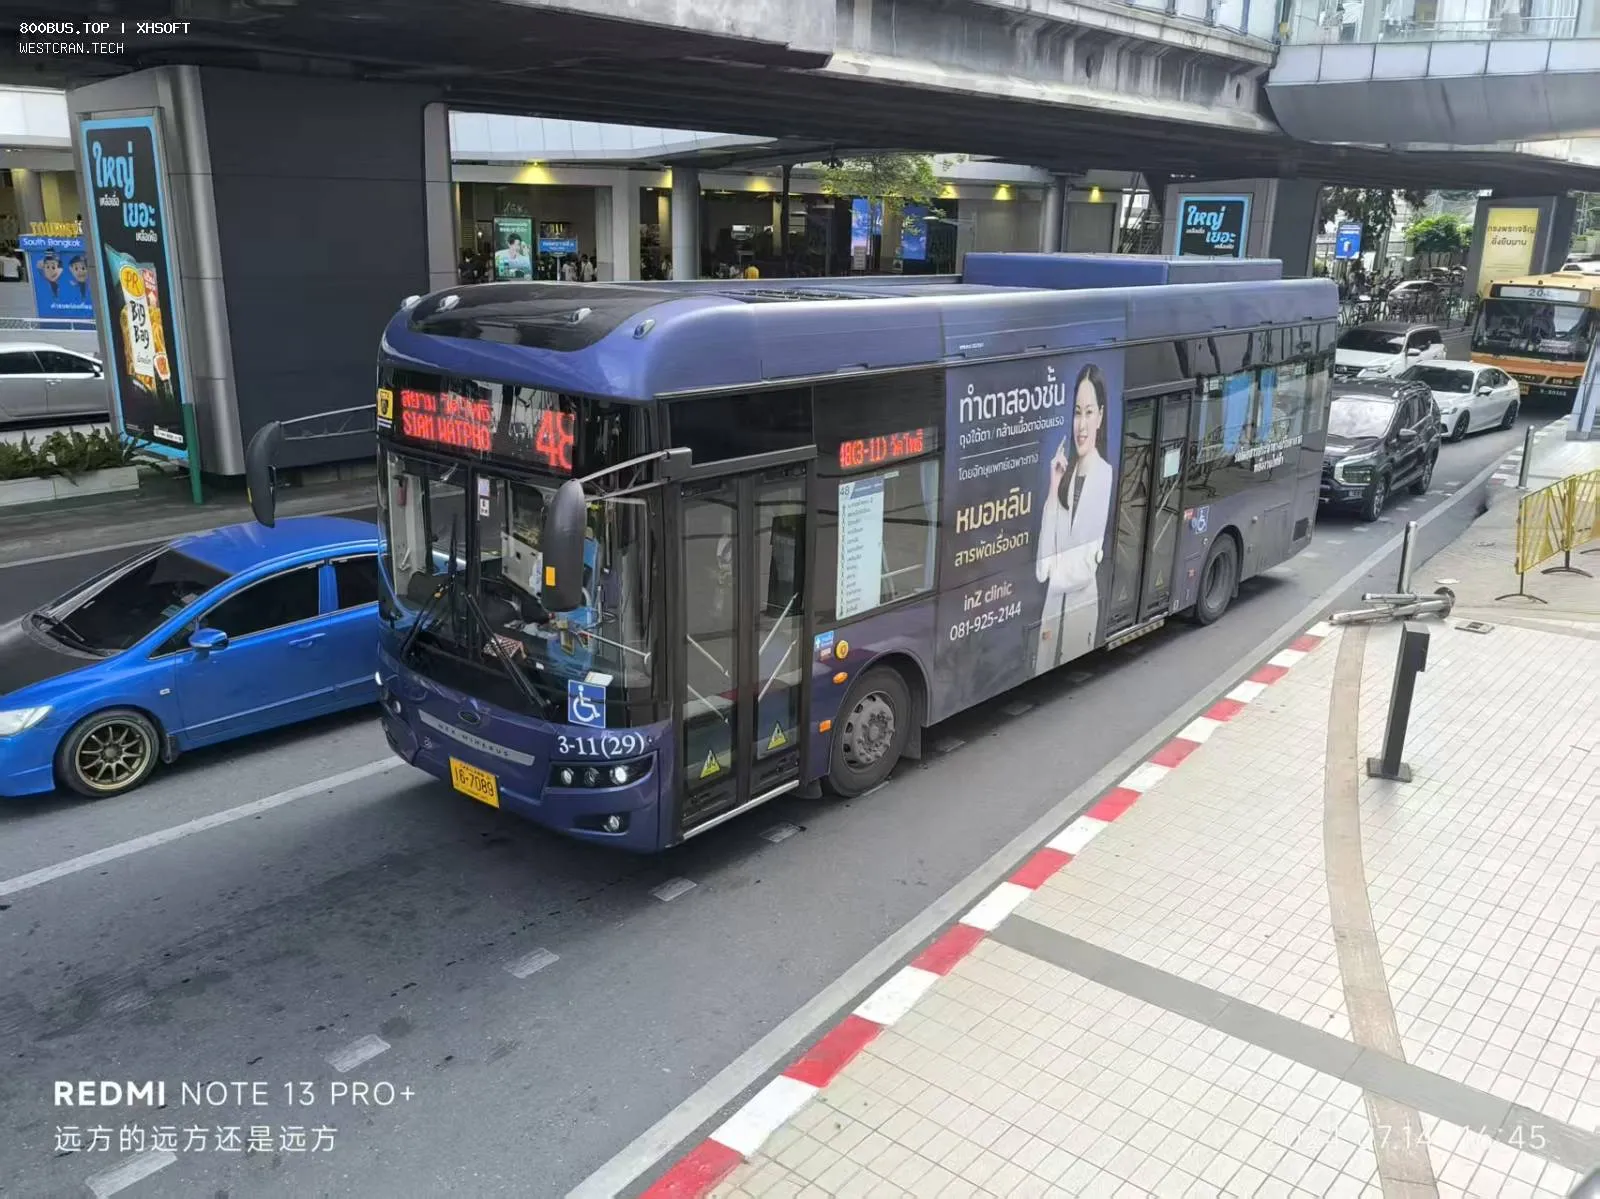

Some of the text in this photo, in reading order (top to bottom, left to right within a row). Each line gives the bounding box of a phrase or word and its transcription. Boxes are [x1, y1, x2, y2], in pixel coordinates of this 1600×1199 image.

[92, 141, 135, 199] ใหญ่
[123, 202, 156, 228] เยอะ
[1187, 205, 1226, 231] ใหญ่
[23, 238, 81, 249] South Bangkok
[1206, 231, 1237, 244] เยอะ
[130, 300, 147, 327] Big
[133, 325, 150, 349] Bag
[959, 366, 1066, 424] ทำตาสองชั้น
[402, 410, 436, 440] SIAM
[959, 427, 991, 452] ถุงใต้ตา
[956, 486, 1032, 534] หมอหลิน
[954, 528, 1029, 568] สารพัดเรื่องตา
[964, 580, 1012, 613] inZ clinic
[950, 600, 1022, 642] 081-925-2144
[558, 731, 645, 759] 3-11(29)
[454, 766, 495, 797] 16-7089
